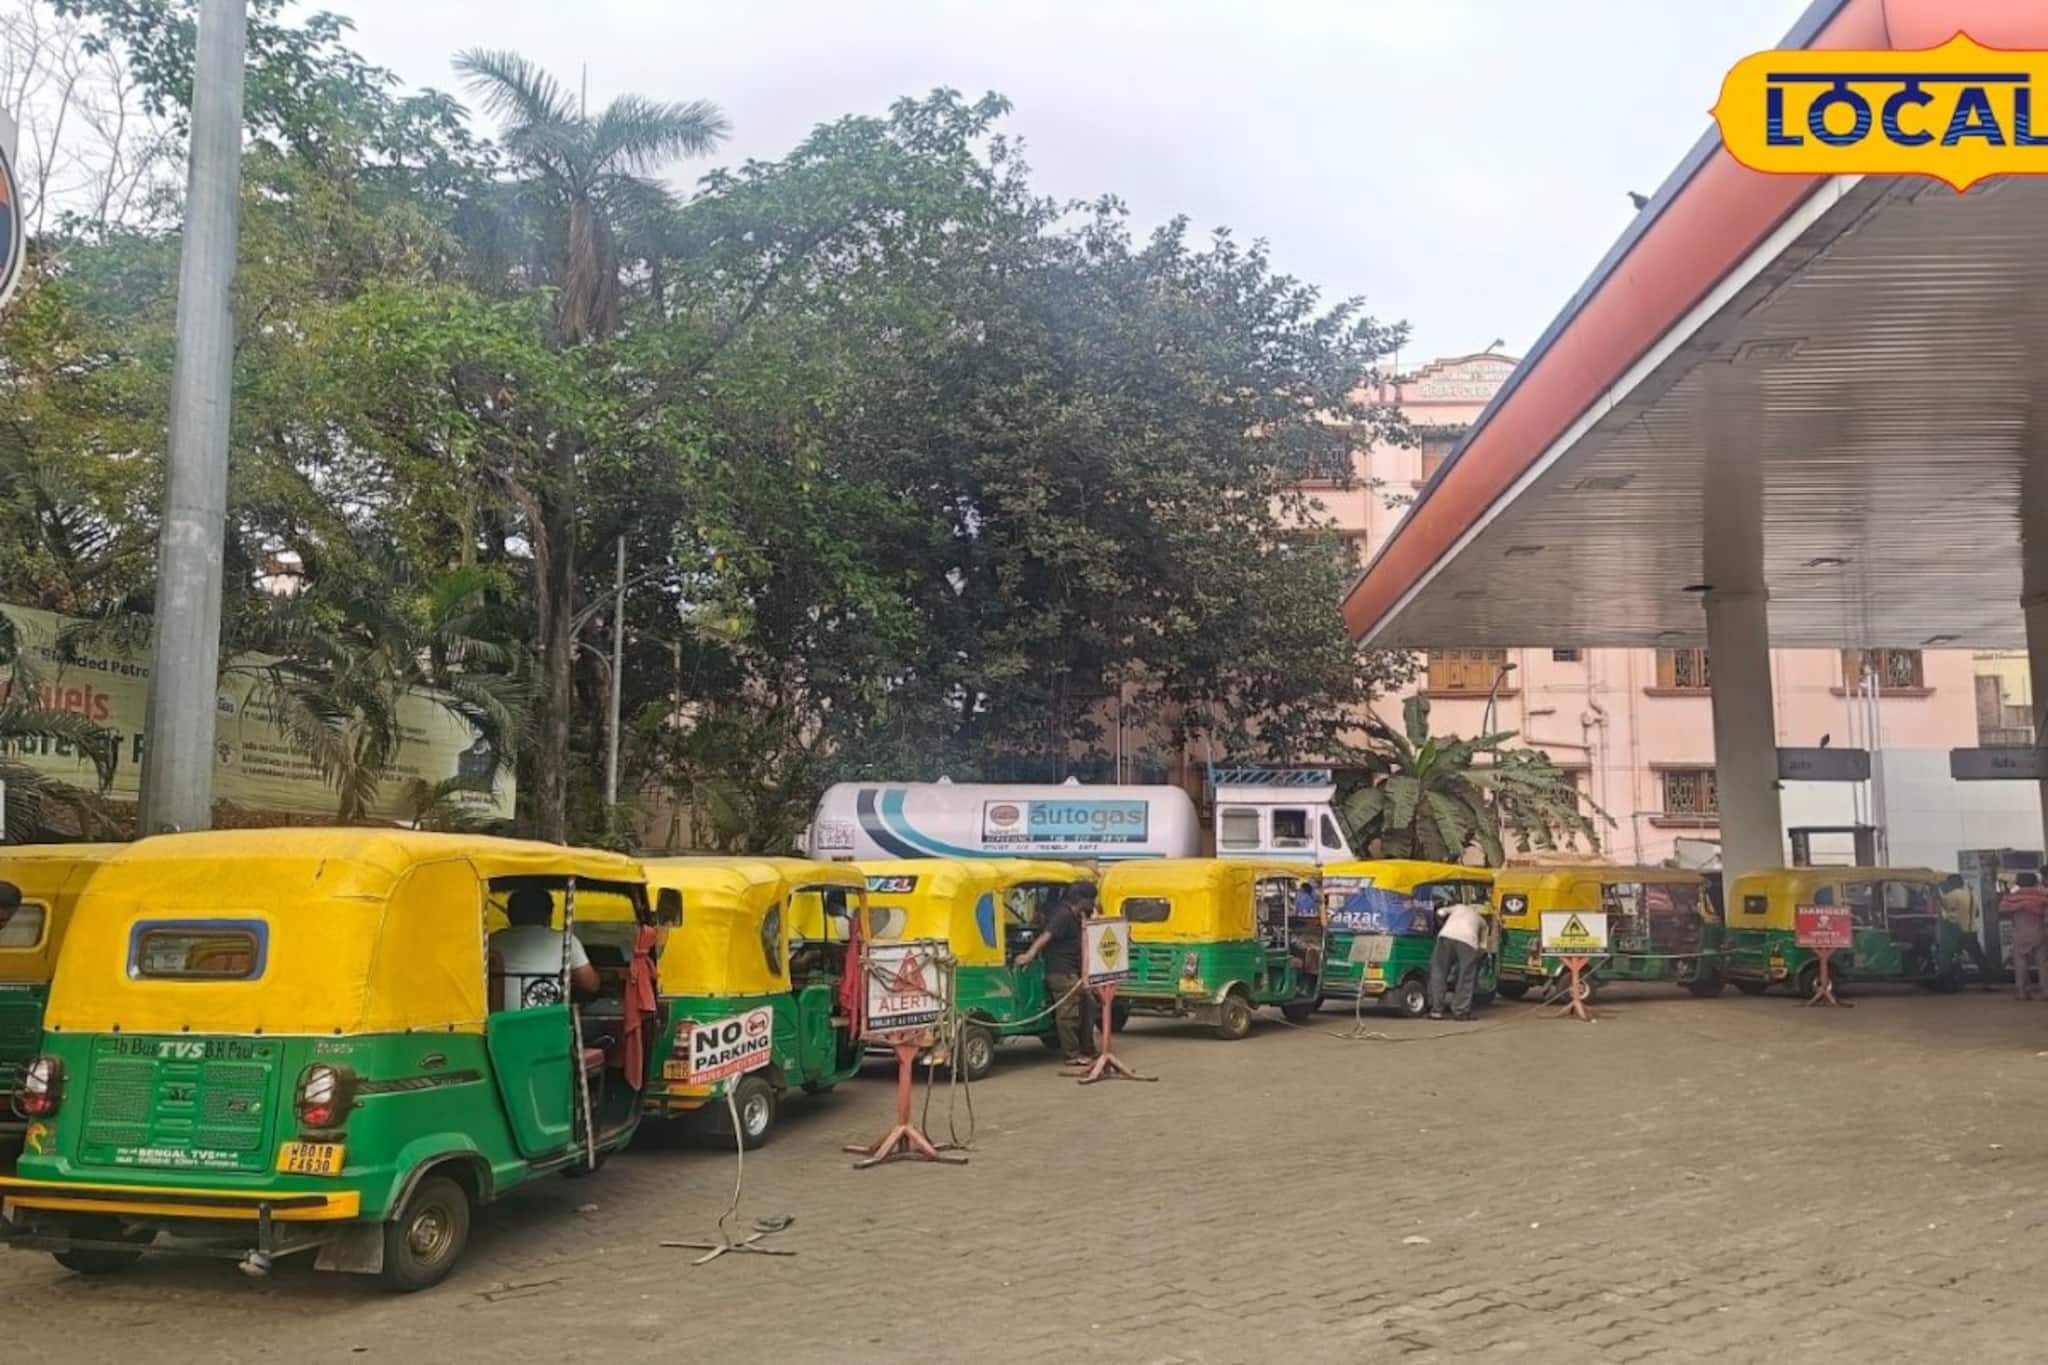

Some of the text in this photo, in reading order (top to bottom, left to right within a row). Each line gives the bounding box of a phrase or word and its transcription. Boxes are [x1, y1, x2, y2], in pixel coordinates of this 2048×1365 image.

[111, 661, 149, 678] Petro
[879, 994, 931, 1013] ALERT
[696, 1022, 742, 1053] NO
[157, 1041, 206, 1059] TVS
[696, 1035, 768, 1070] PARKING
[138, 1148, 185, 1159] BENGAL
